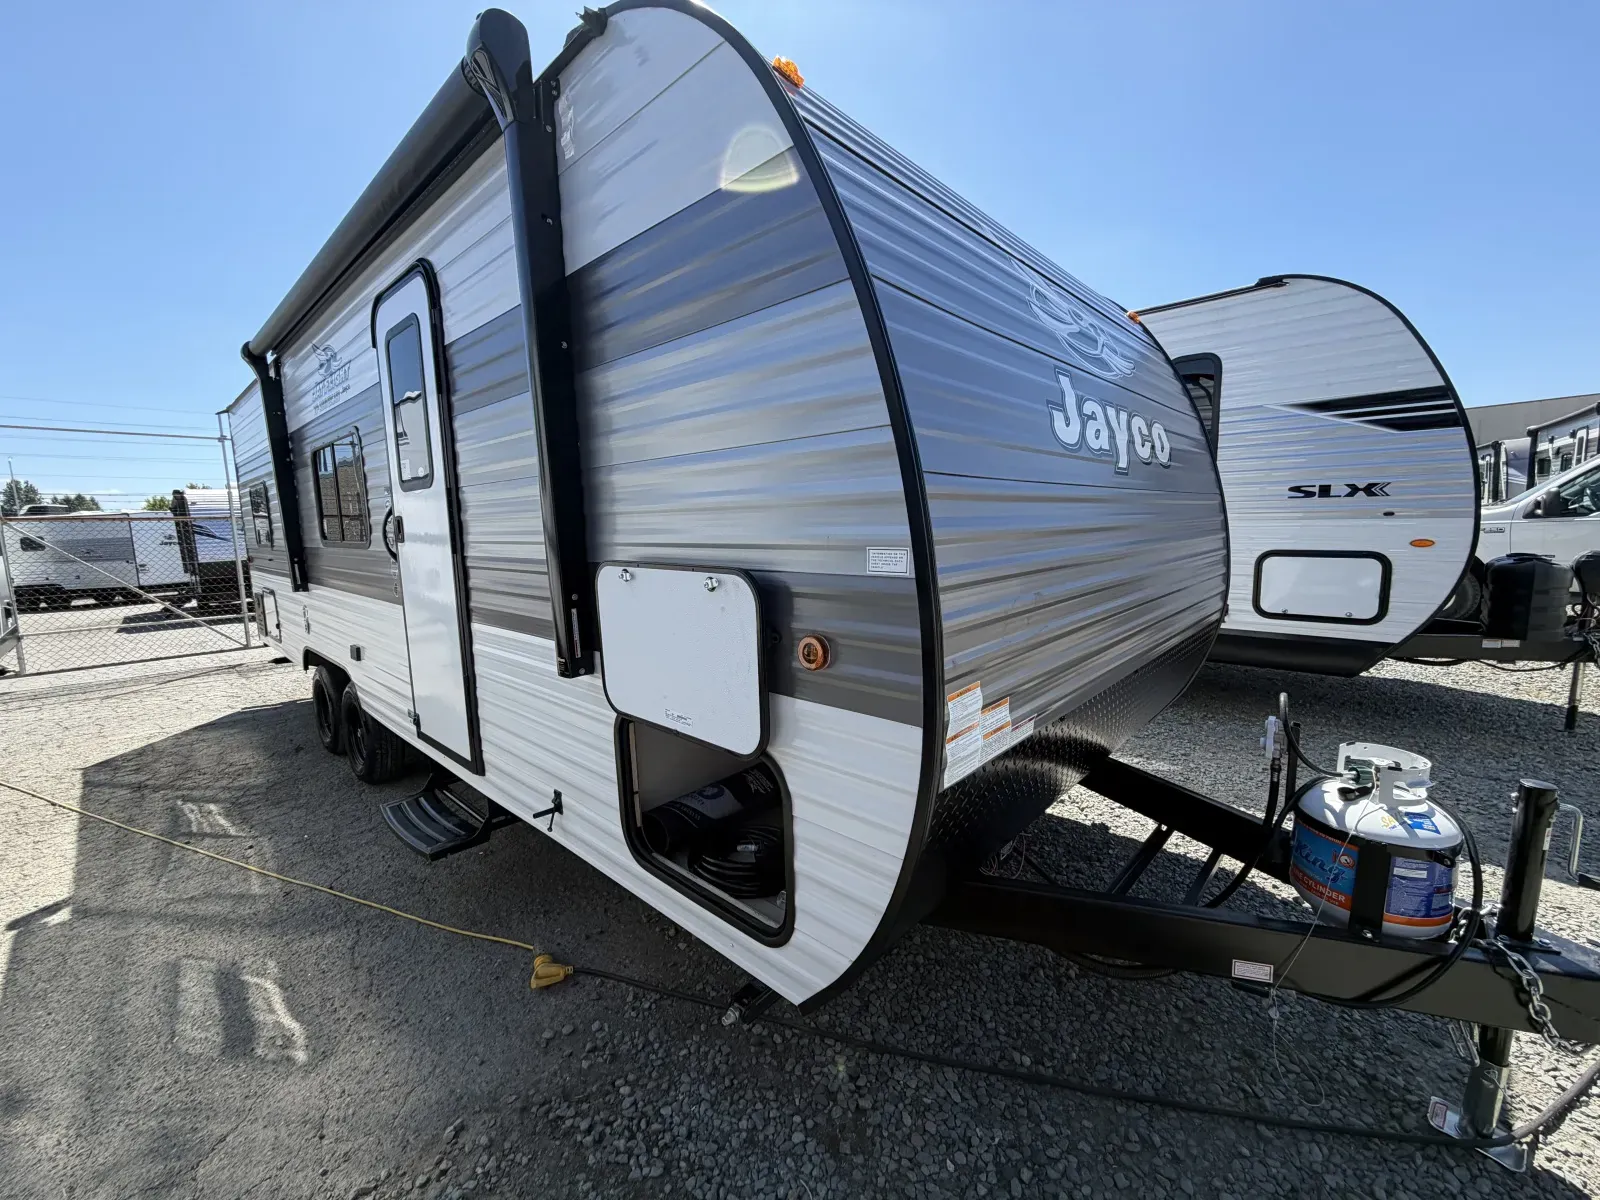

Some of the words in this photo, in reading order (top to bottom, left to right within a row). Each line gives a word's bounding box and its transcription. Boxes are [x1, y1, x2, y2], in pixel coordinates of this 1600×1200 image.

[1047, 366, 1171, 475] Jayco
[1287, 482, 1388, 499] SLX
[1294, 841, 1347, 884] King
[1303, 875, 1346, 903] CYLINDER
